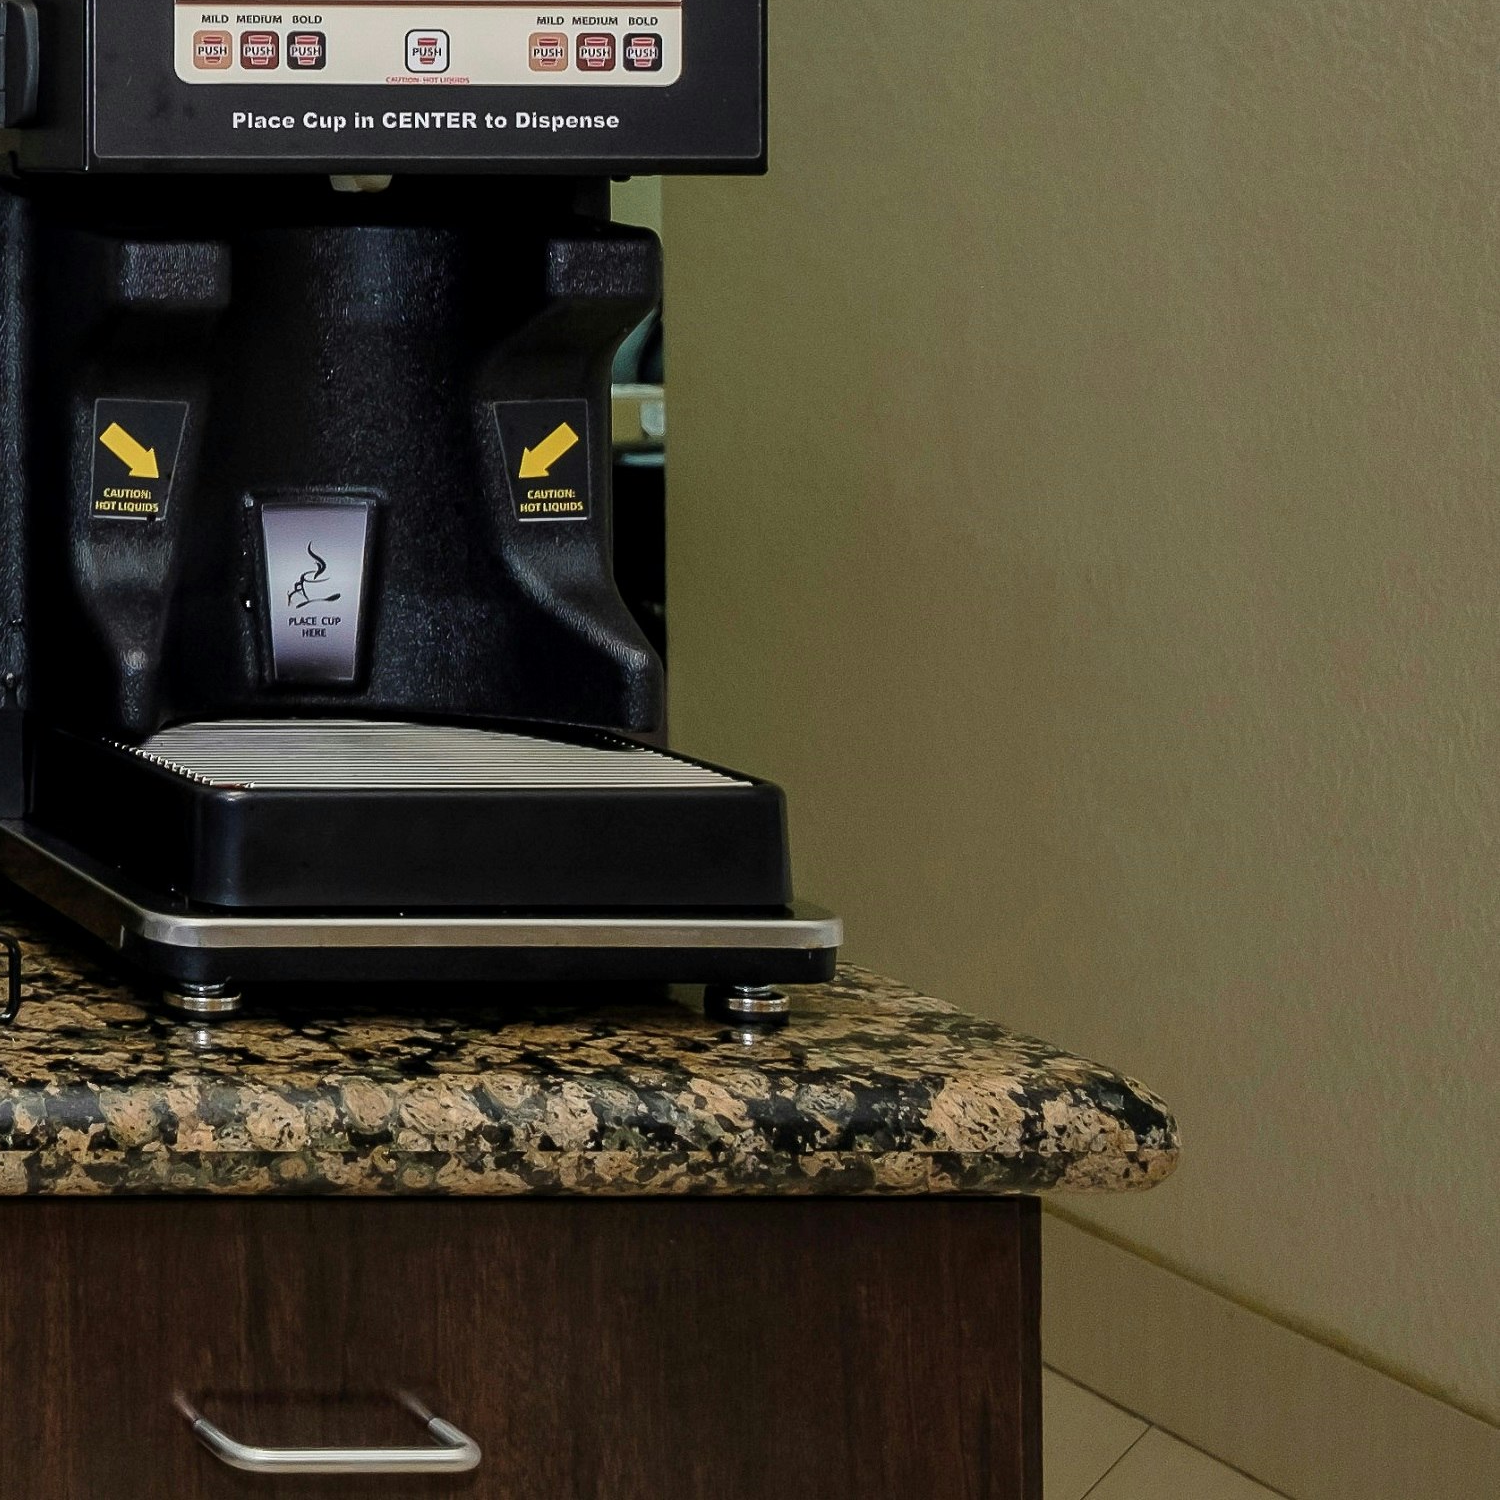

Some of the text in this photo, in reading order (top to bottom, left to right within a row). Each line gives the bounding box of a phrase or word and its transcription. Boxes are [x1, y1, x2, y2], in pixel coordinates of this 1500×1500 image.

[201, 15, 229, 24] MILD
[236, 15, 282, 24] MEDIUM
[292, 15, 322, 24] BOLD
[536, 16, 565, 26] MILD
[572, 16, 618, 26] MEDIUM
[628, 16, 658, 26] BOLD
[198, 46, 228, 56] PUSH
[244, 46, 275, 56] PUSH
[291, 46, 322, 57] PUSH
[412, 47, 442, 57] PUSH
[533, 47, 563, 57] PUSH
[580, 47, 611, 58] PUSH
[627, 47, 658, 58] PUSH
[232, 112, 620, 132] Place Cup in CENTER to Dispense
[103, 488, 152, 500] CAUTION:
[527, 488, 576, 500] CAUTION:
[95, 500, 159, 513] HOT LIQUIDS
[520, 501, 584, 513] HOT LIQUIDS
[288, 616, 341, 627] PLACE CUP
[302, 628, 327, 638] HERE
